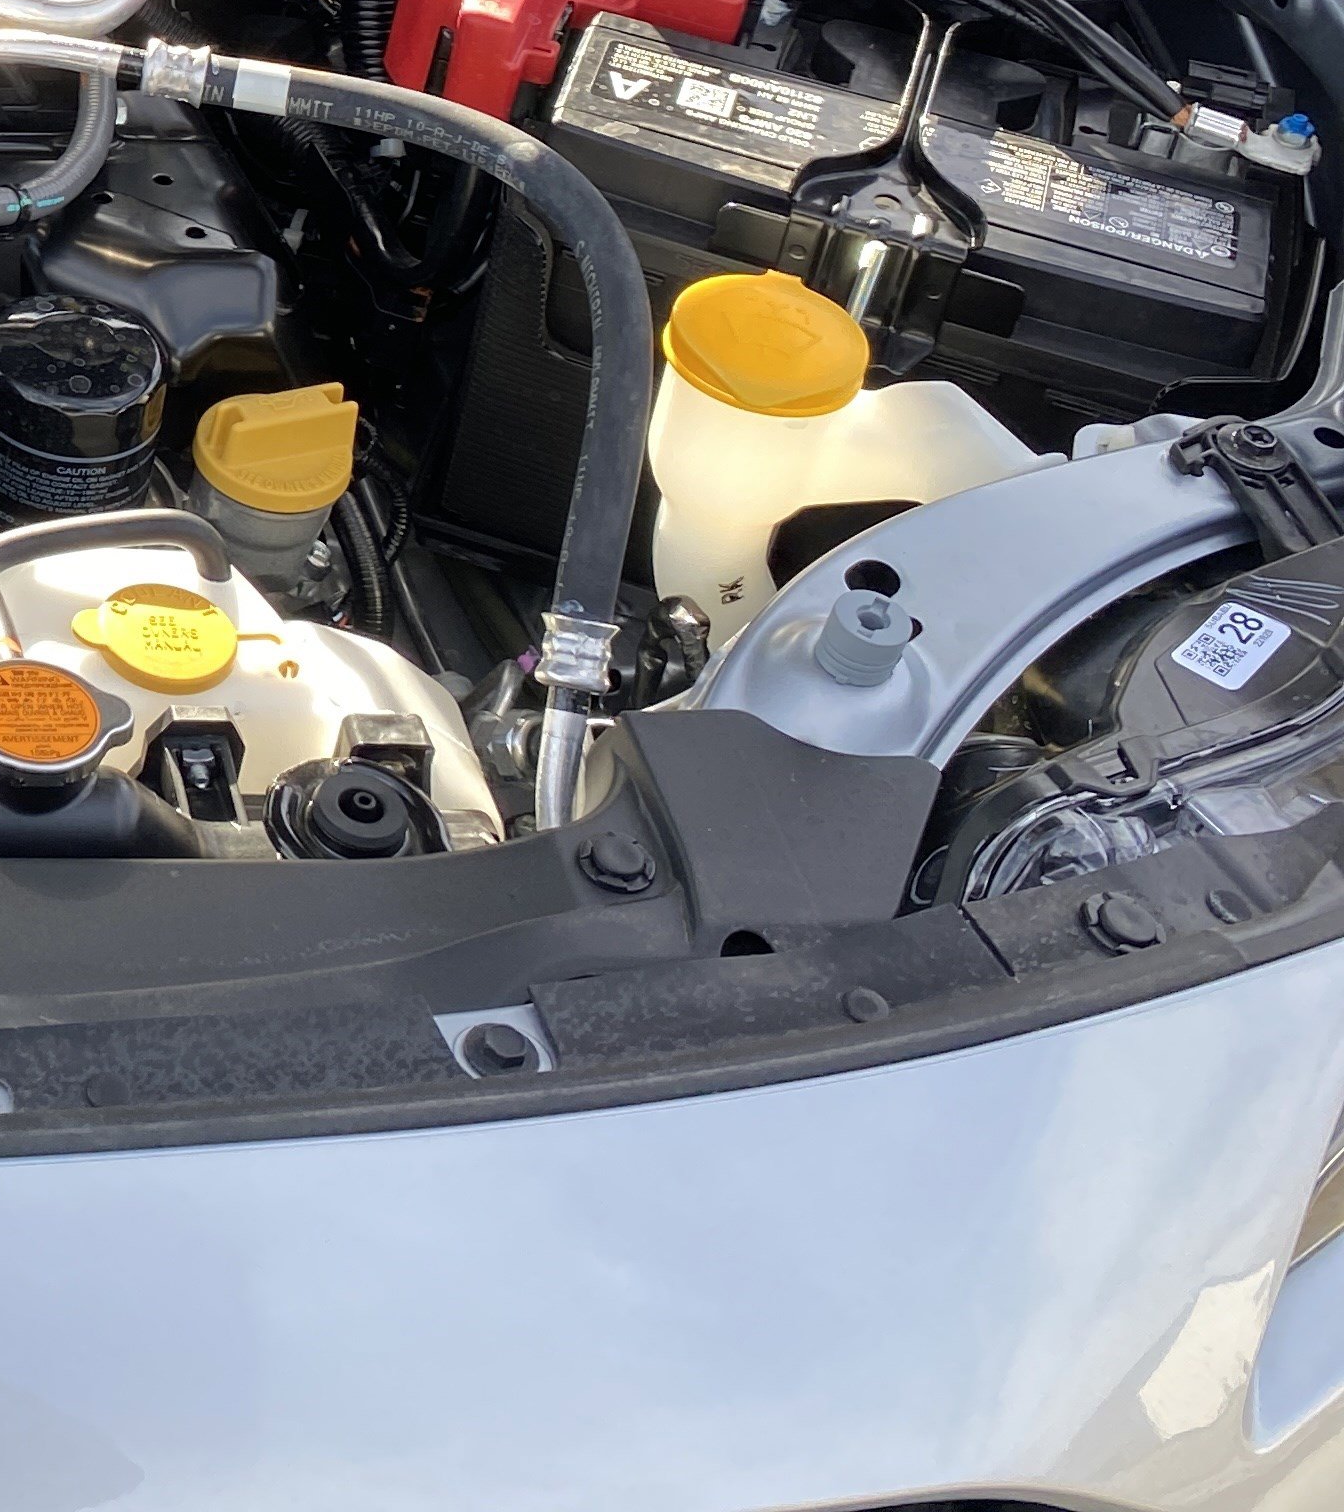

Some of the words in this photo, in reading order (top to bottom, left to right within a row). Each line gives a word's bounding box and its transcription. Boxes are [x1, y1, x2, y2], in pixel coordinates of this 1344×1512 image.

[289, 97, 333, 120] MMIT
[777, 133, 809, 148] COLD
[1067, 214, 1195, 255] DANGER/POISON
[56, 466, 107, 476] CAUTION
[1217, 611, 1263, 645] 28
[1, 735, 79, 743] AVERTISSEMENT
